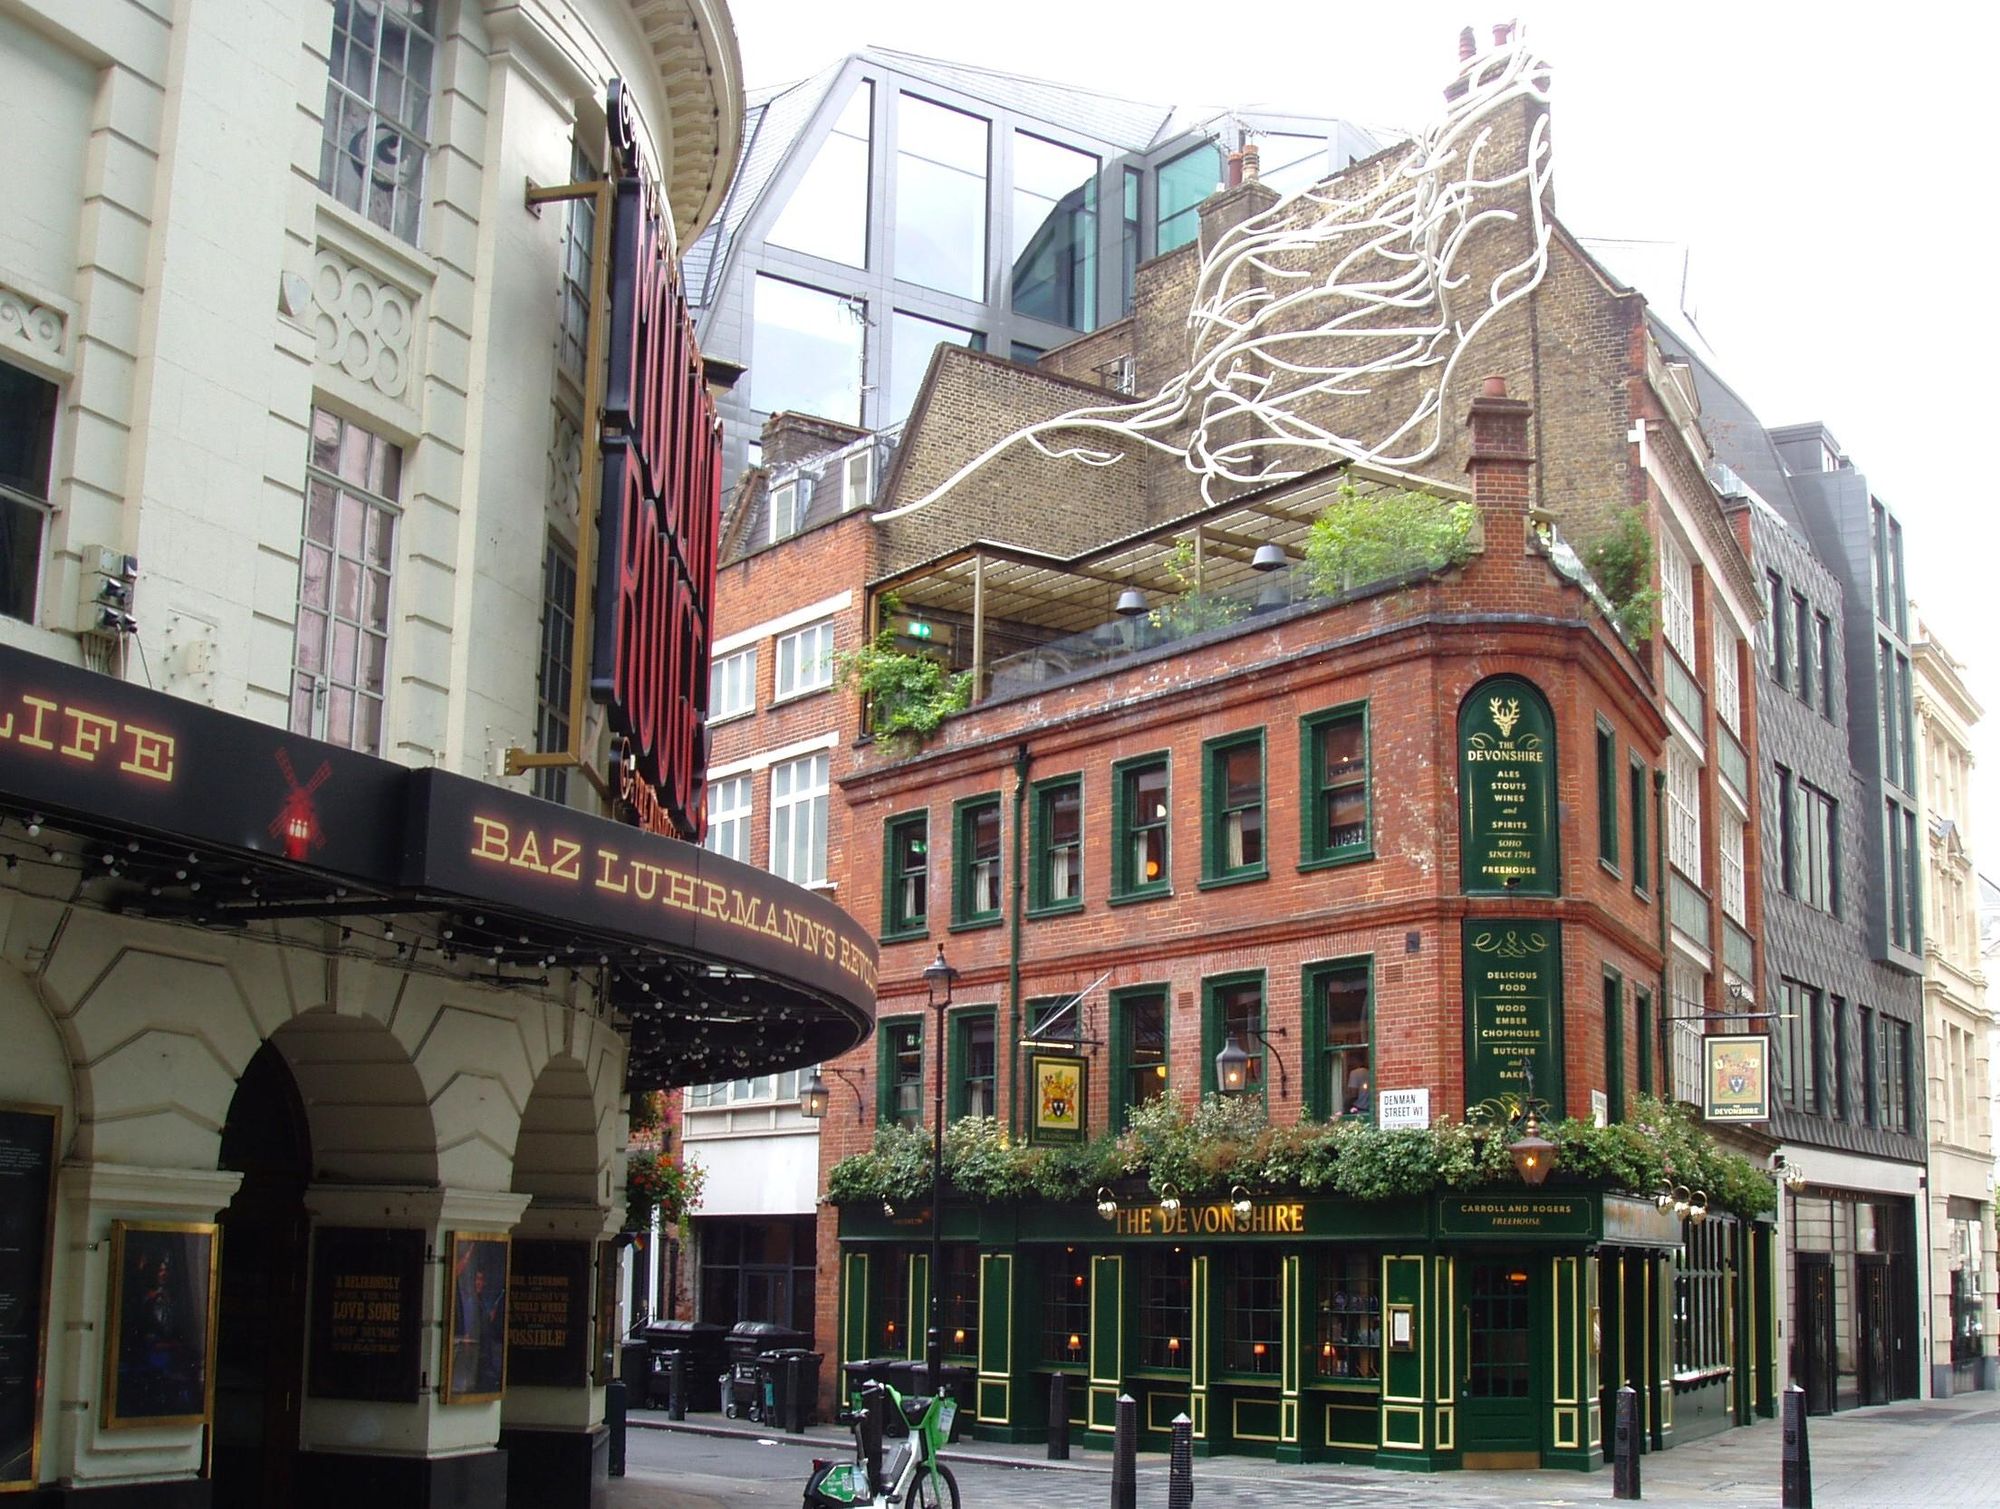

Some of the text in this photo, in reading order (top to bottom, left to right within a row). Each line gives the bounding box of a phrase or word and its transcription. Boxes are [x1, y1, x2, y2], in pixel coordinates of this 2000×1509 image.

[0, 695, 174, 781] IFE
[1498, 741, 1515, 749] THE
[1467, 750, 1544, 762] DEVONSHIRE
[1491, 782, 1527, 790] STOUTS
[1494, 794, 1525, 802] WINES
[1492, 821, 1528, 829] SPIRITS
[1498, 840, 1522, 848] SOHO
[1488, 851, 1513, 859] SINCE
[1482, 866, 1537, 874] FREEHOUSE
[471, 816, 581, 881] BAZ
[594, 850, 836, 962] LUHRMANN'S
[1487, 971, 1537, 979] DELICIOUS
[1496, 1004, 1526, 1012] WOOD
[1495, 1017, 1527, 1025] EMBER
[1482, 1029, 1541, 1037] CHOPHOUSE
[1492, 1047, 1536, 1055] BUTCHER
[1384, 1094, 1416, 1105] DENMAN
[1384, 1106, 1423, 1118] STREET W1
[1714, 1107, 1760, 1115] DEVONSHIRE
[1460, 1204, 1571, 1213] CARROLL AND ROGERS
[1116, 1208, 1152, 1234] THE
[1491, 1217, 1541, 1226] FREEHOUSE
[333, 1301, 400, 1321] LOVE SONG
